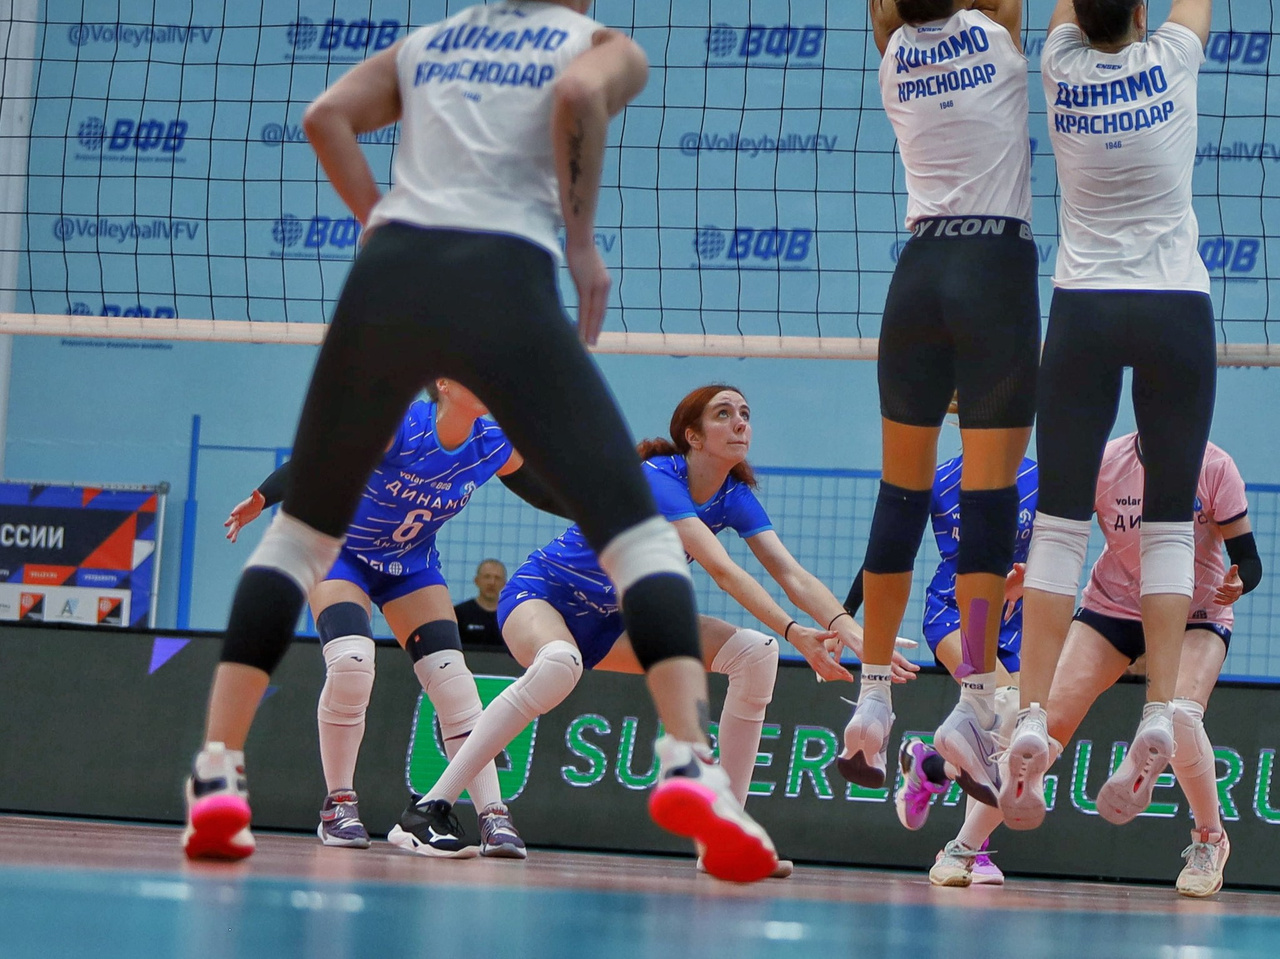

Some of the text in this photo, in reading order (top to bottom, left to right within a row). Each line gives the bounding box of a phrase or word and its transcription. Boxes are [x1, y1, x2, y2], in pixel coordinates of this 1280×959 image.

[739, 24, 825, 58] ВФВ
[895, 25, 990, 74] ДИНАМО
[1206, 29, 1272, 64] ФВ
[897, 63, 997, 103] КРАСНОДАР
[1054, 65, 1168, 109] ДИНАМО
[1054, 100, 1175, 134] КРАСНОДАР
[108, 118, 189, 152] ВФВ
[304, 216, 363, 248] ВФ
[727, 227, 813, 261] ВФВ
[934, 218, 1006, 237] ICON
[1200, 238, 1261, 272] ФВ
[385, 479, 470, 510] ДИНАМО
[400, 471, 425, 486] volar
[1115, 495, 1141, 506] volar
[392, 508, 433, 543] 6
